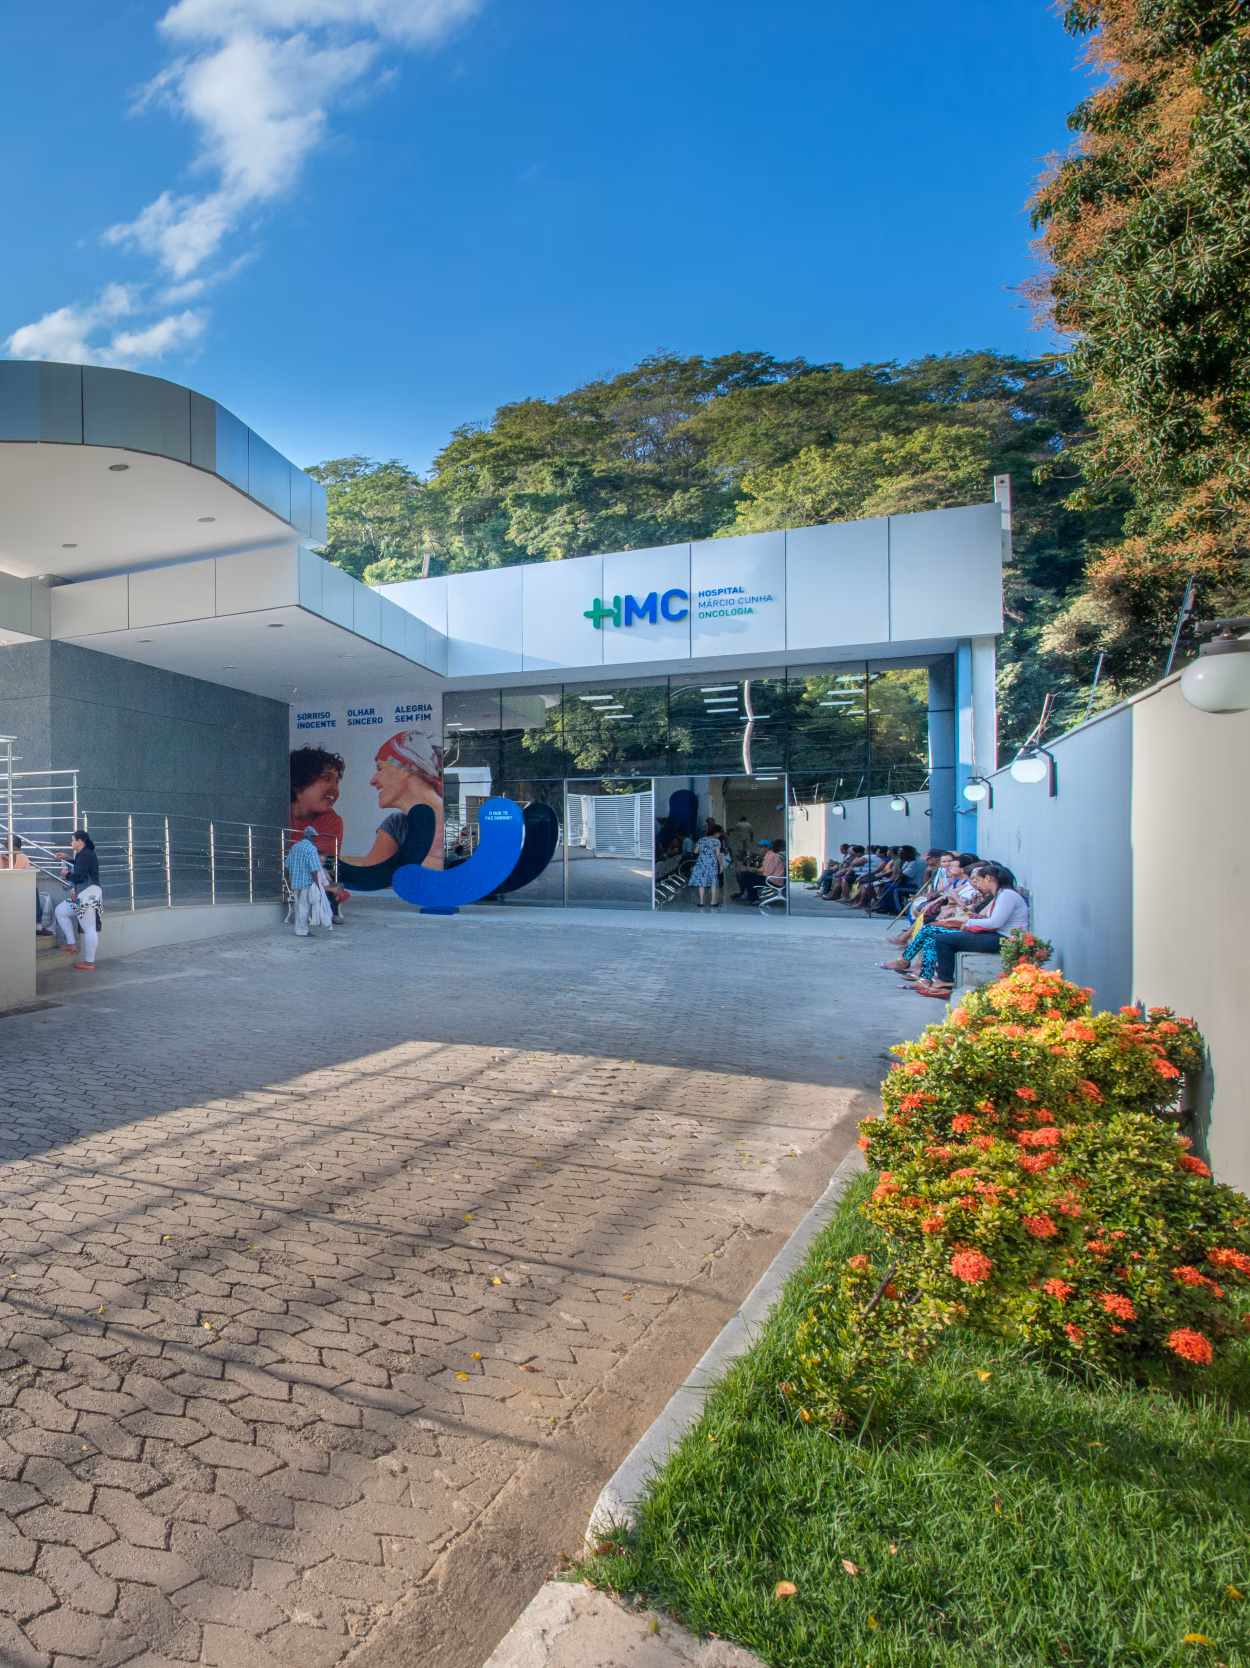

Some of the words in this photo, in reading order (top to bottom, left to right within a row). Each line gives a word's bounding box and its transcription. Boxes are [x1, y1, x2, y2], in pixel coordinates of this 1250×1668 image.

[698, 586, 744, 597] HOSPITAL
[698, 598, 735, 608] MÁRCIO
[737, 594, 773, 605] CUNHA
[583, 589, 688, 629] HMC
[698, 607, 753, 619] ONCOLOGIA
[347, 708, 375, 717] OLHAR
[395, 704, 432, 713] ALEGRIA
[297, 712, 330, 720] SORRISO
[415, 713, 431, 721] FIM
[297, 720, 336, 729] INOCENTE
[347, 717, 383, 726] SINCERO
